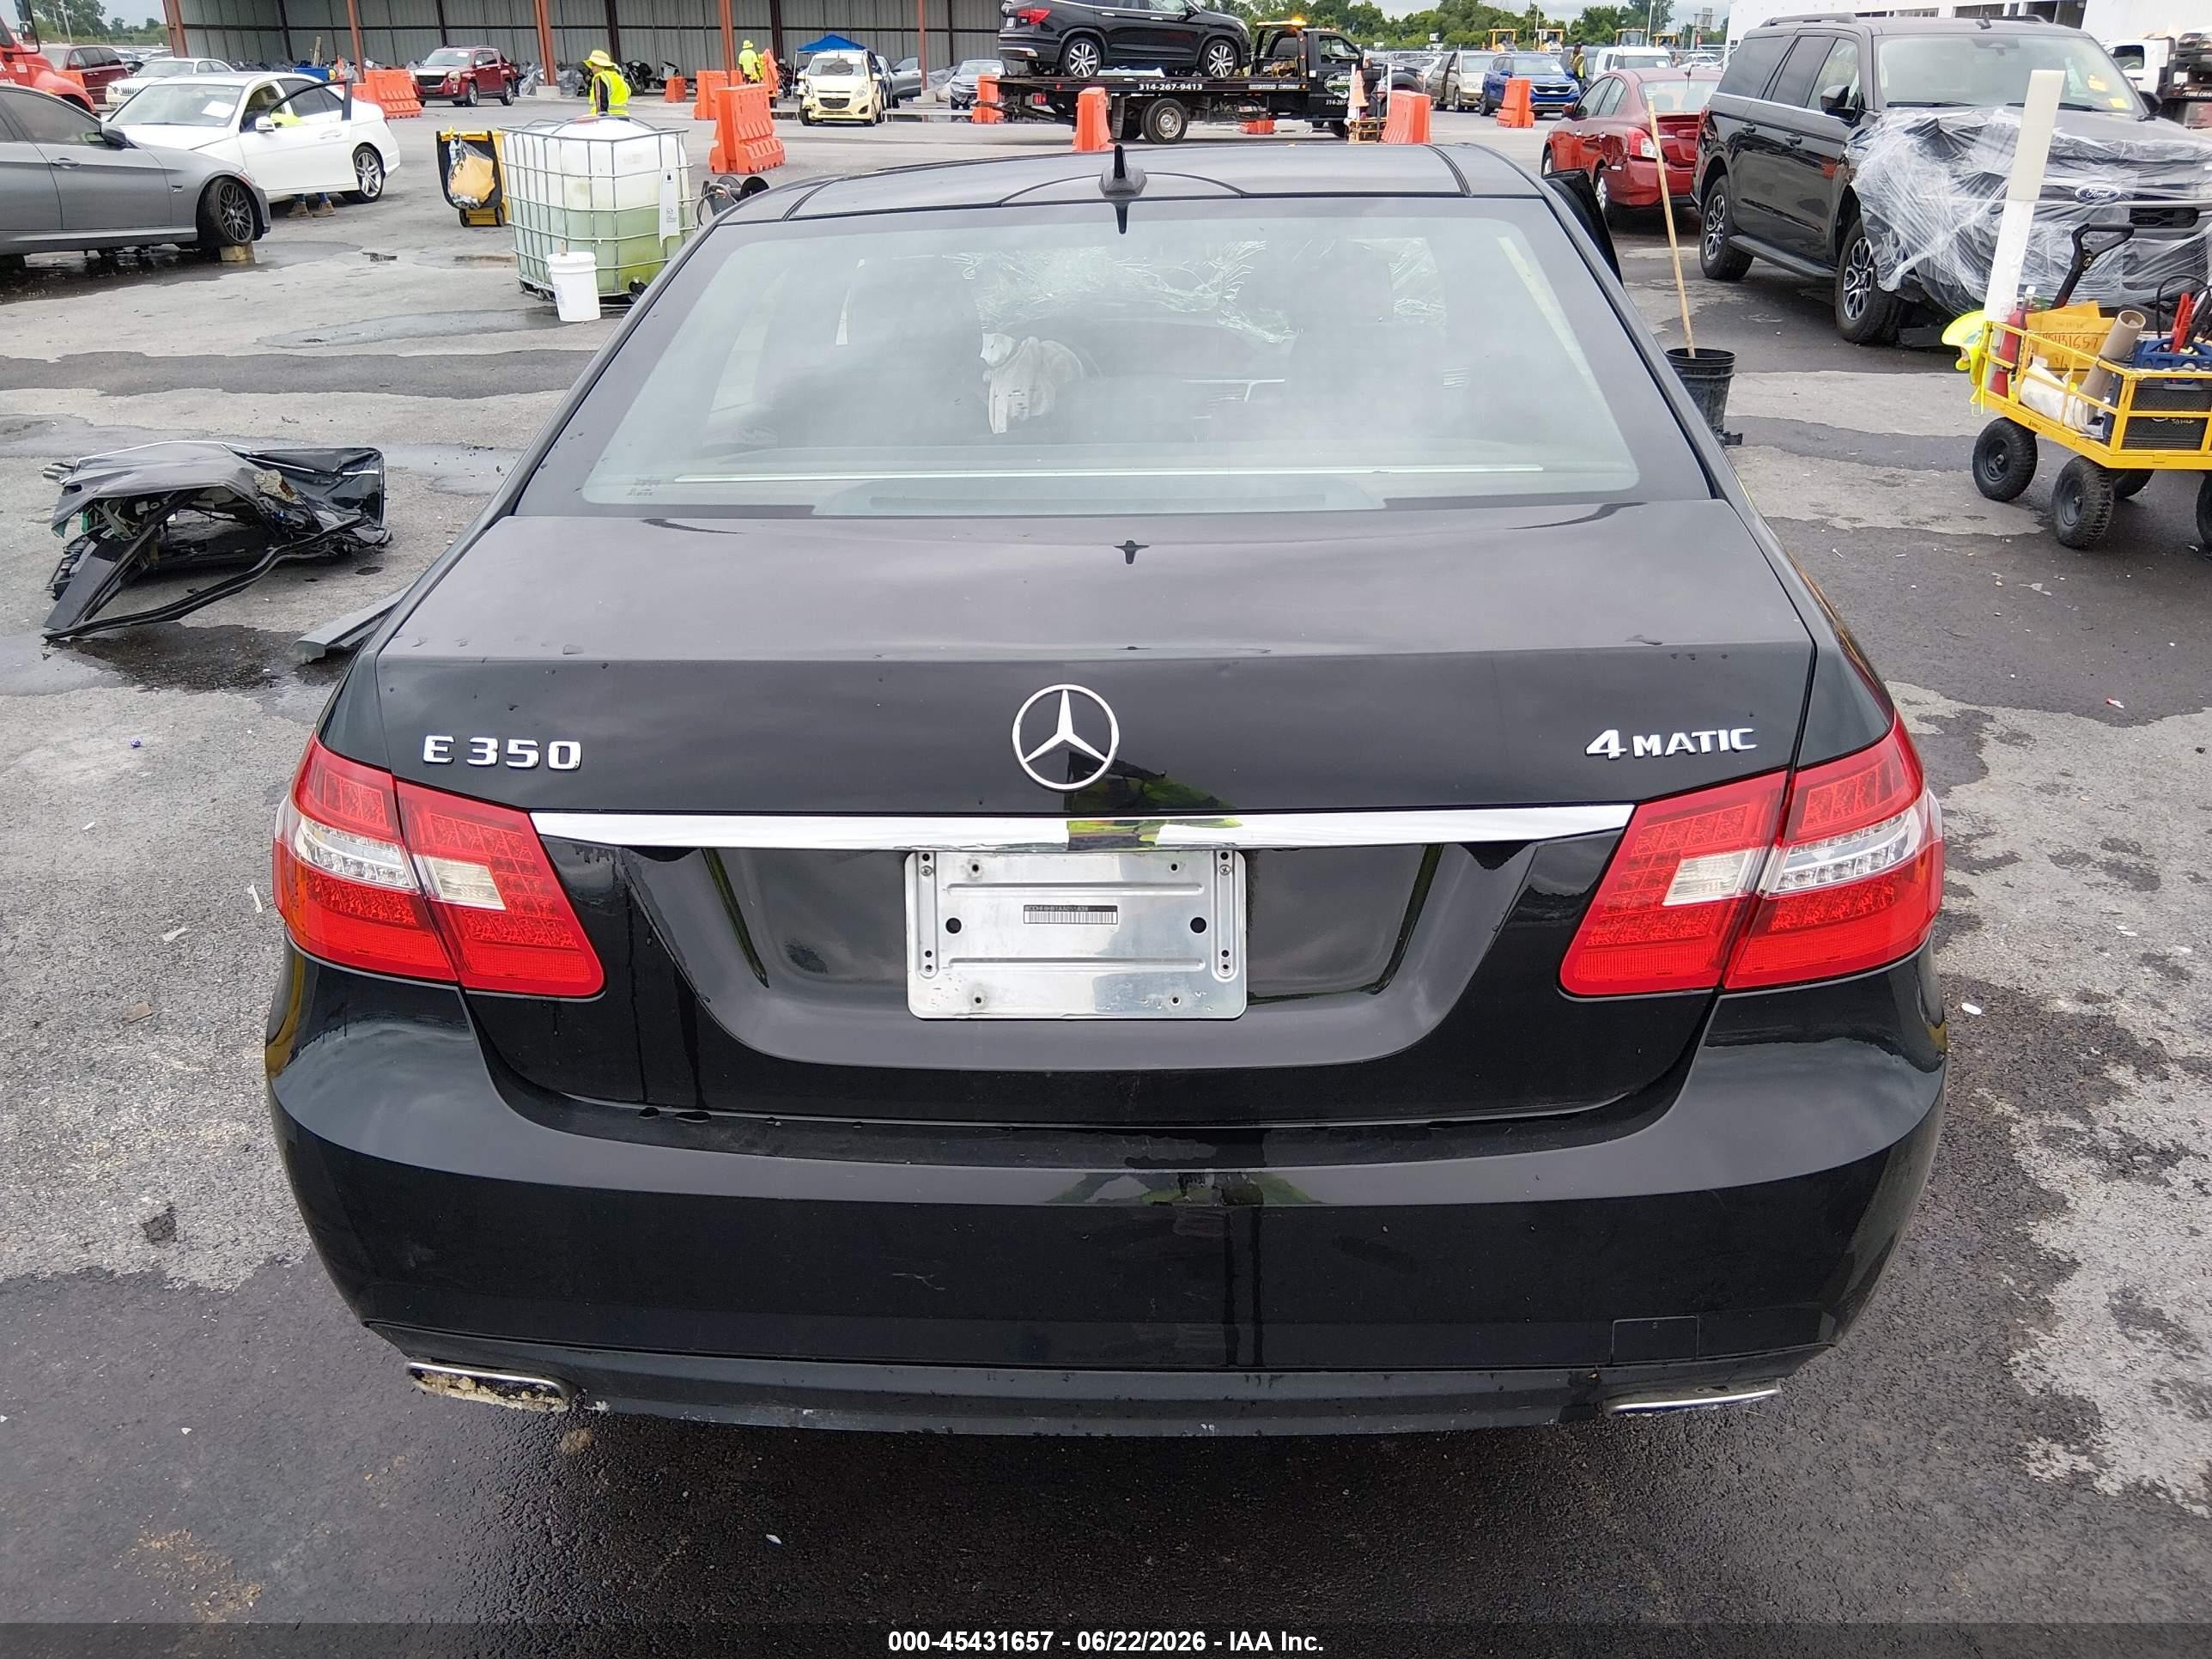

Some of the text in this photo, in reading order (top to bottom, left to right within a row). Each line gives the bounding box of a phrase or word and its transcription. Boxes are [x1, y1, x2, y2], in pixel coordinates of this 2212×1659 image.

[2086, 188, 2111, 198] Ford
[422, 735, 583, 771] E 350
